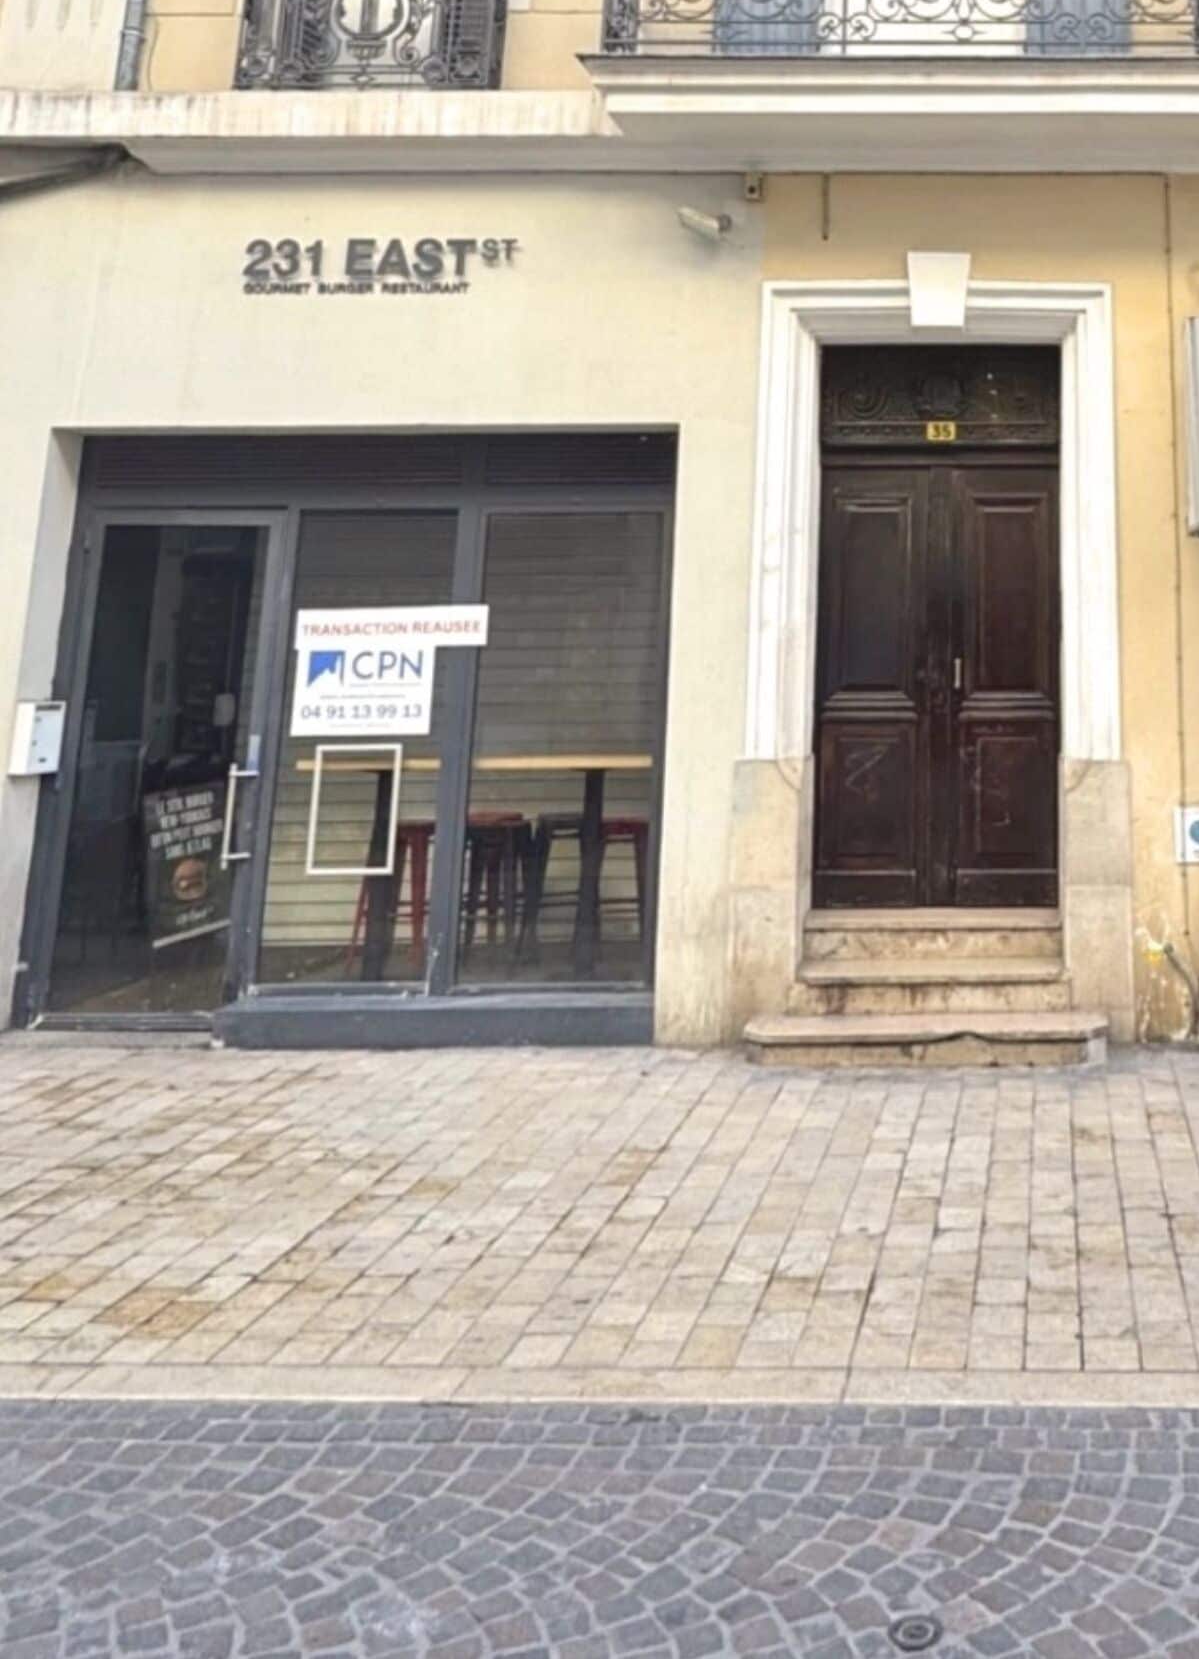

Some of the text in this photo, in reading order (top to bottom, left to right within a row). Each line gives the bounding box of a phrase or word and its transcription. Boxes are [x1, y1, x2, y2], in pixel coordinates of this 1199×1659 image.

[243, 238, 519, 278] 231 EAST ST
[243, 283, 470, 295] GOURMET BURGER RESTAURANT
[932, 423, 952, 438] 35
[303, 622, 408, 637] TRANSACTION
[352, 649, 424, 680] CPN
[301, 703, 422, 719] 04 91 13 99 13
